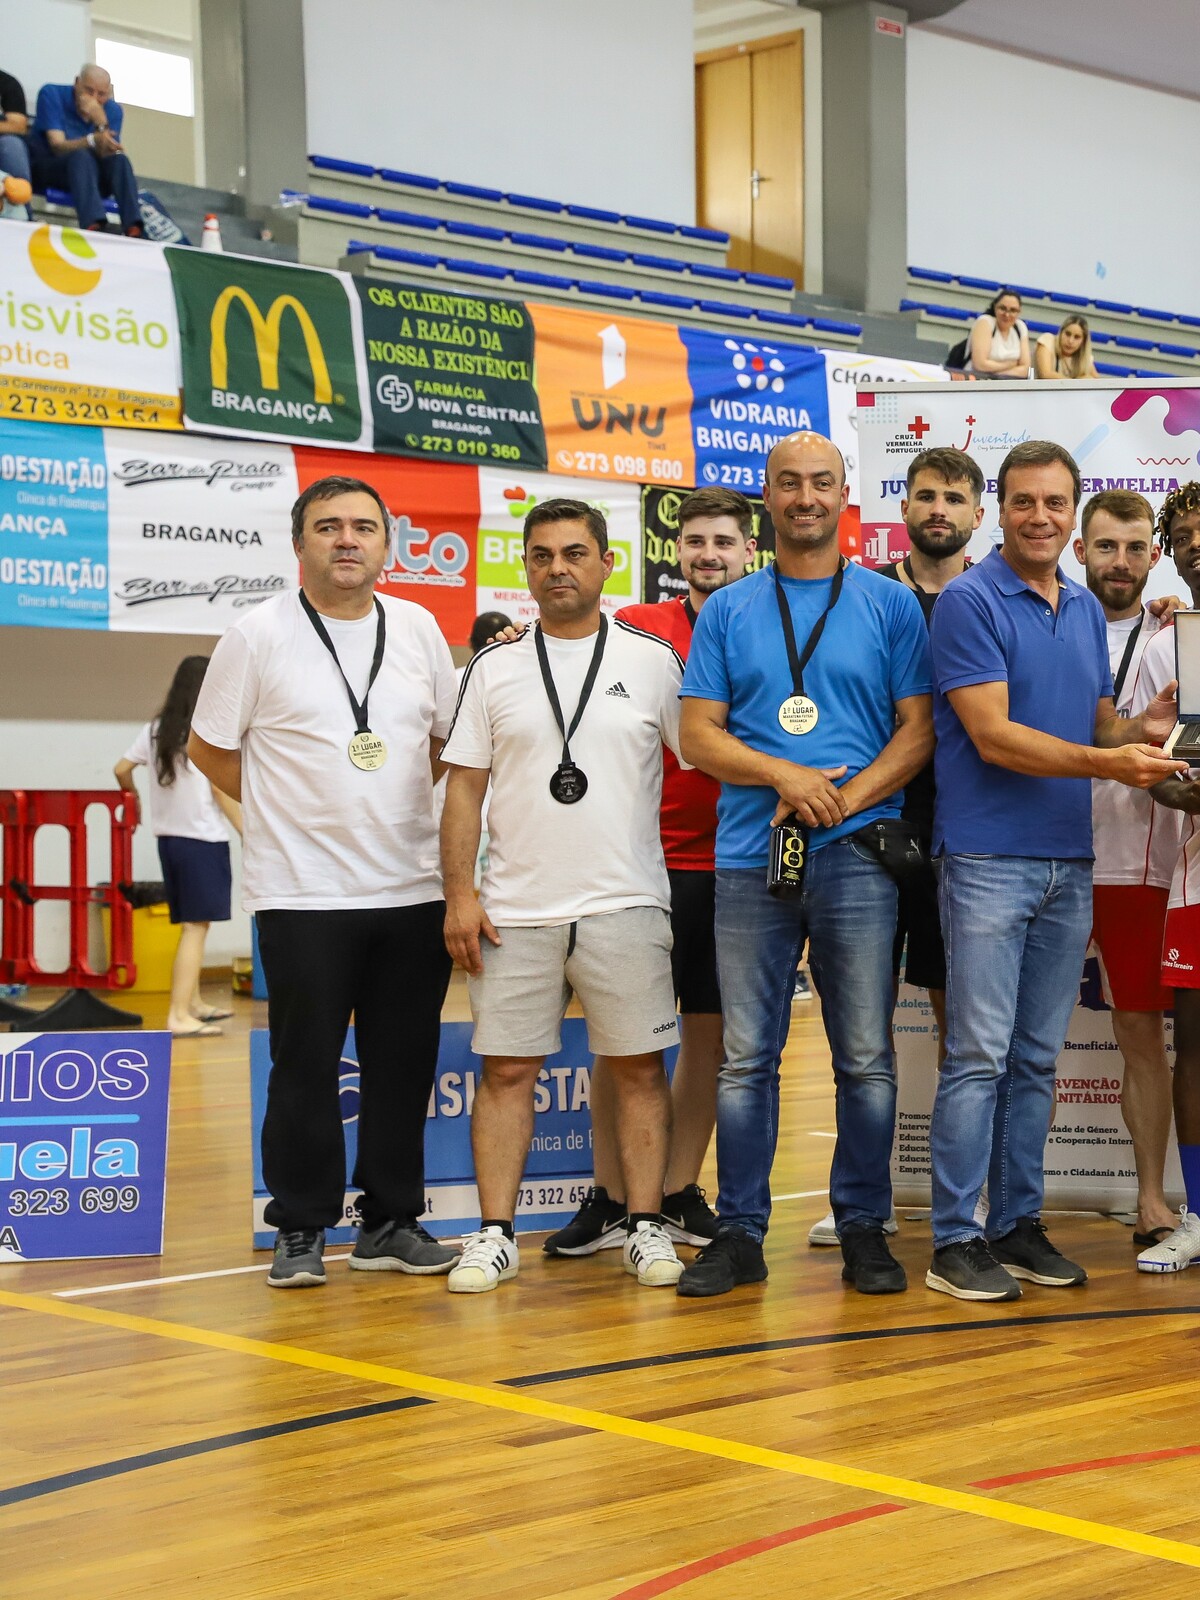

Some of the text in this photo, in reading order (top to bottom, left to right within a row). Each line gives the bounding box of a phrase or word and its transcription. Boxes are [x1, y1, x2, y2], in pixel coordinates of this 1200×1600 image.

[0, 290, 168, 349] isvisão
[368, 286, 524, 329] OS CLIENTES SÃO
[400, 317, 503, 353] A RAZÃO DA
[368, 340, 530, 382] NOSSA EXISTÊNCI
[414, 379, 487, 402] FARMÁCIA
[9, 394, 57, 416] 273
[63, 400, 109, 420] 329
[211, 389, 333, 424] BRAGANÇA
[417, 397, 540, 425] NOVA CENTRAL
[571, 397, 667, 438] UNU
[710, 398, 812, 430] VIDRARIA
[431, 418, 492, 437] BRAGANÇA
[422, 435, 521, 461] 273 010 360
[113, 459, 285, 486] Bar Praia
[574, 451, 684, 481] 273 098 600
[720, 465, 753, 486] 273
[142, 523, 263, 550] BRAGANÇA
[114, 574, 288, 604] Bar Praia
[606, 690, 631, 699] adidas
[361, 742, 382, 750] LUGAR
[652, 1020, 677, 1035] adidas
[892, 1024, 929, 1034] Jovens
[0, 1049, 149, 1102] IOS
[1057, 1091, 1122, 1105] NITÁRIOS
[566, 1132, 584, 1151] de
[1056, 1136, 1107, 1145] Cooperação
[1087, 1126, 1118, 1134] Género
[1070, 1168, 1115, 1176] Cidadania
[8, 1185, 140, 1217] 323 699
[538, 1187, 565, 1205] 322
